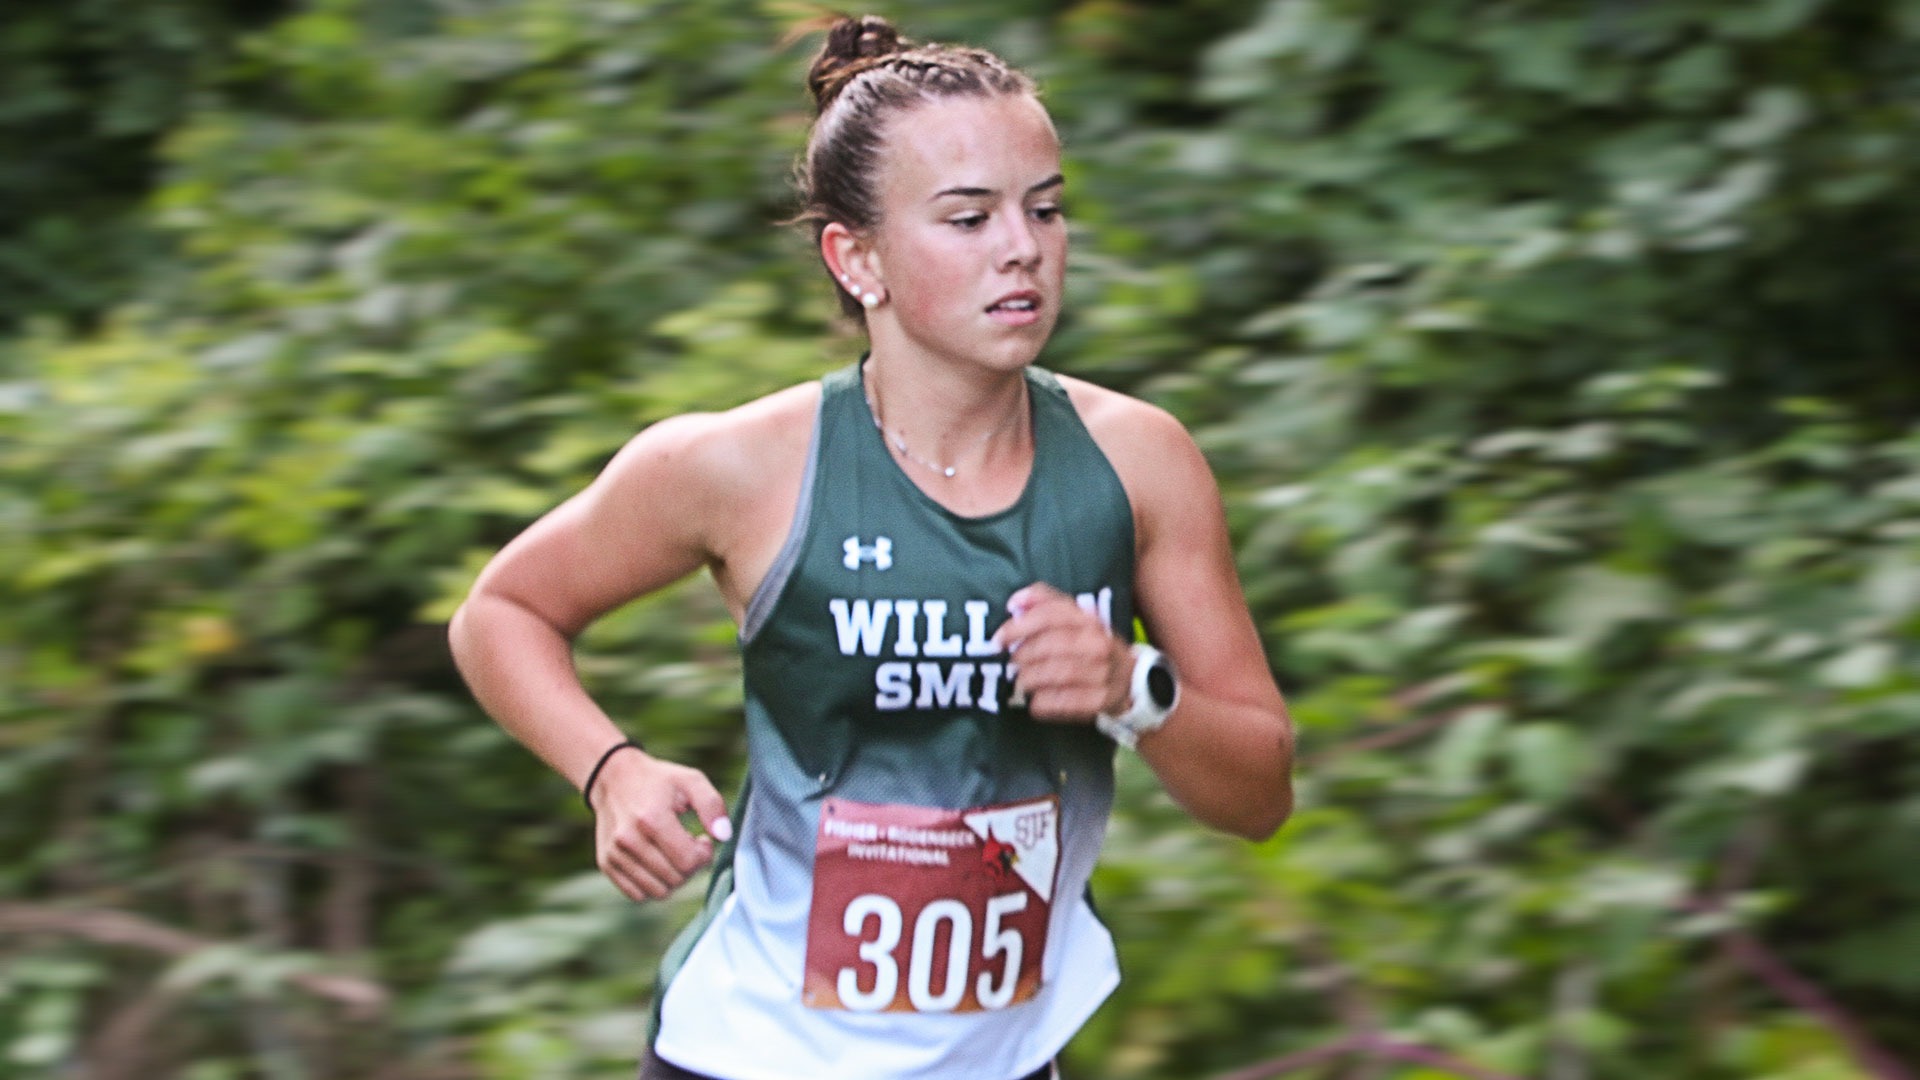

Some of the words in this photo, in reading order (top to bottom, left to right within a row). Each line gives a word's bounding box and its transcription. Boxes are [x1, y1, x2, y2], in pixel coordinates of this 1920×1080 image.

[829, 587, 1113, 657] WILL
[847, 843, 950, 866] INVITATIONAL
[837, 891, 1028, 1012] 305
